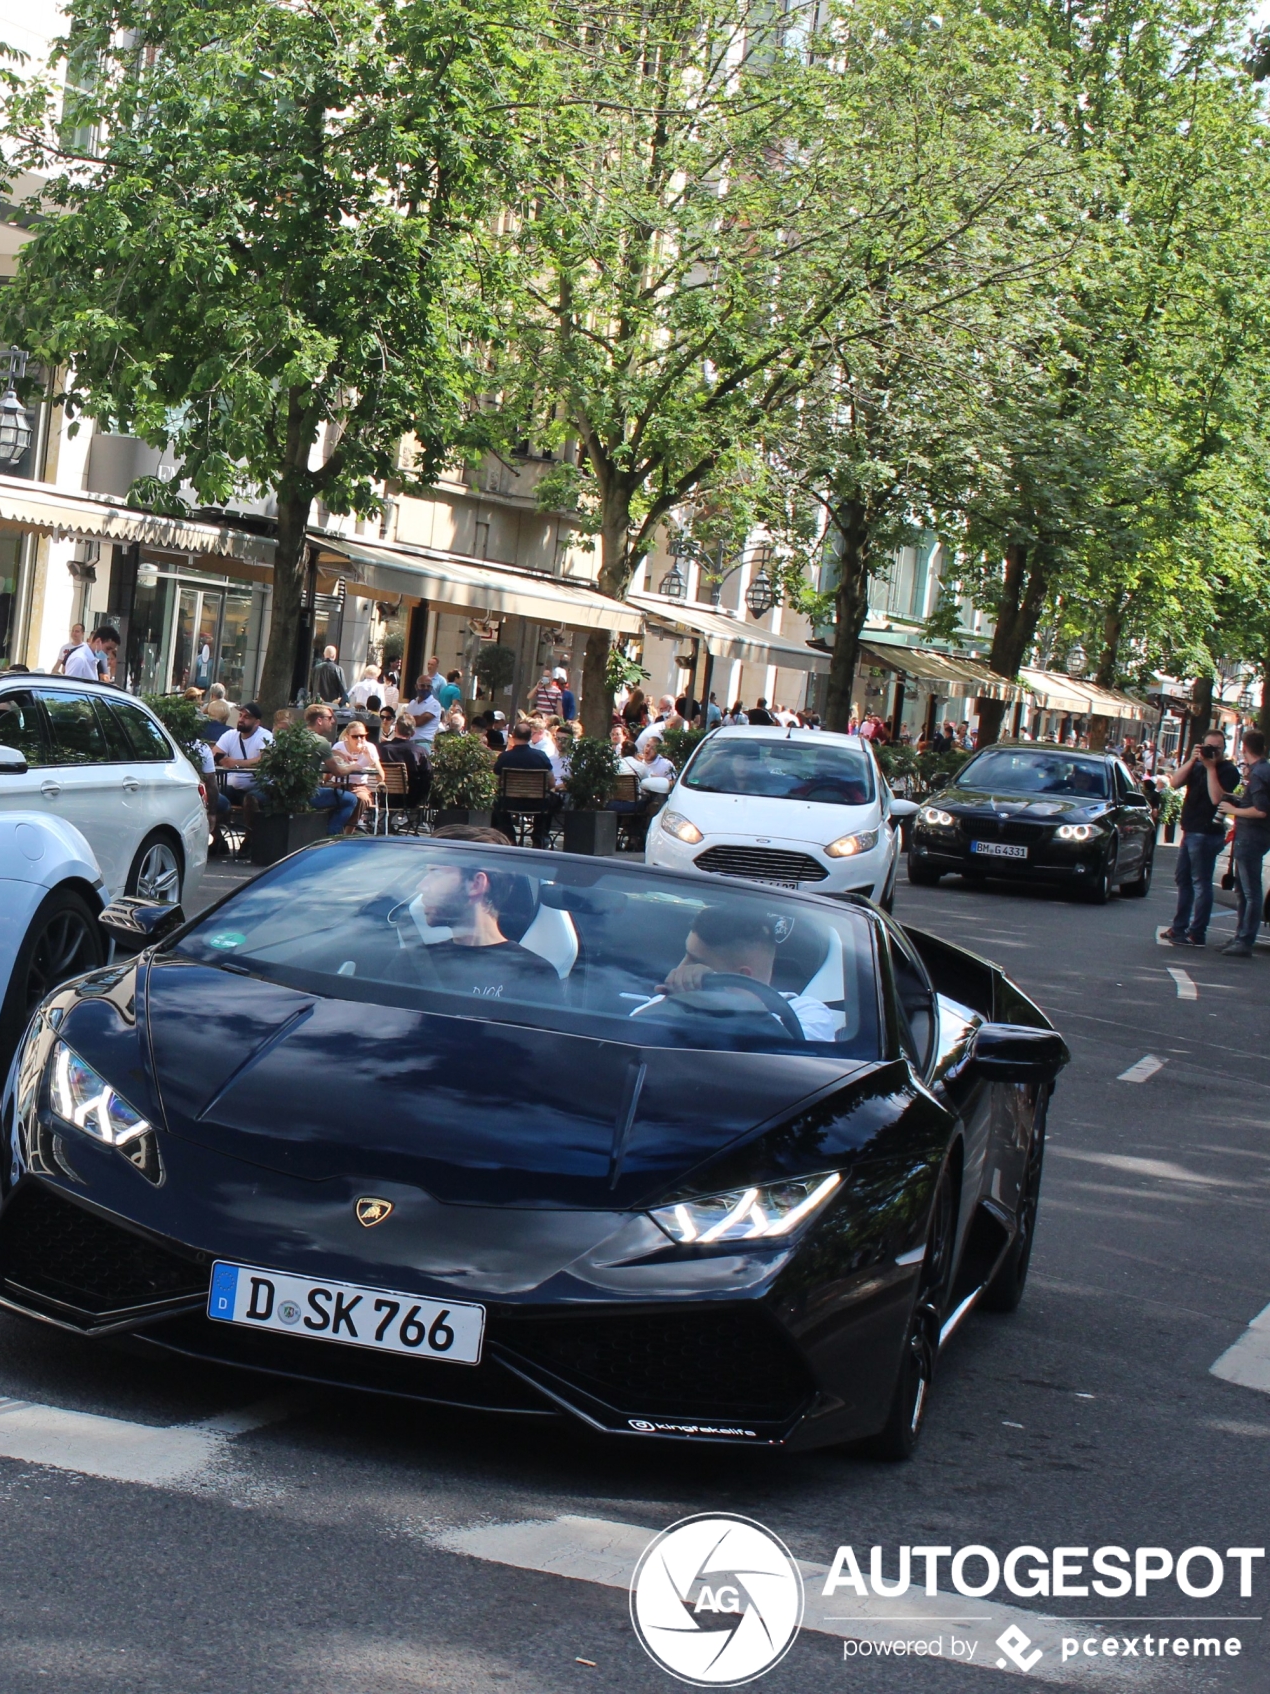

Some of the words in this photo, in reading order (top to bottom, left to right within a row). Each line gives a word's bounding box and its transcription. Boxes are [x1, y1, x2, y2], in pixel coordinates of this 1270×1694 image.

[977, 842, 989, 852] BM
[995, 845, 1001, 854] G
[1002, 846, 1025, 857] 4331
[218, 1297, 227, 1310] D
[246, 1276, 276, 1321] D
[303, 1287, 364, 1338] SK
[373, 1298, 455, 1352] 766
